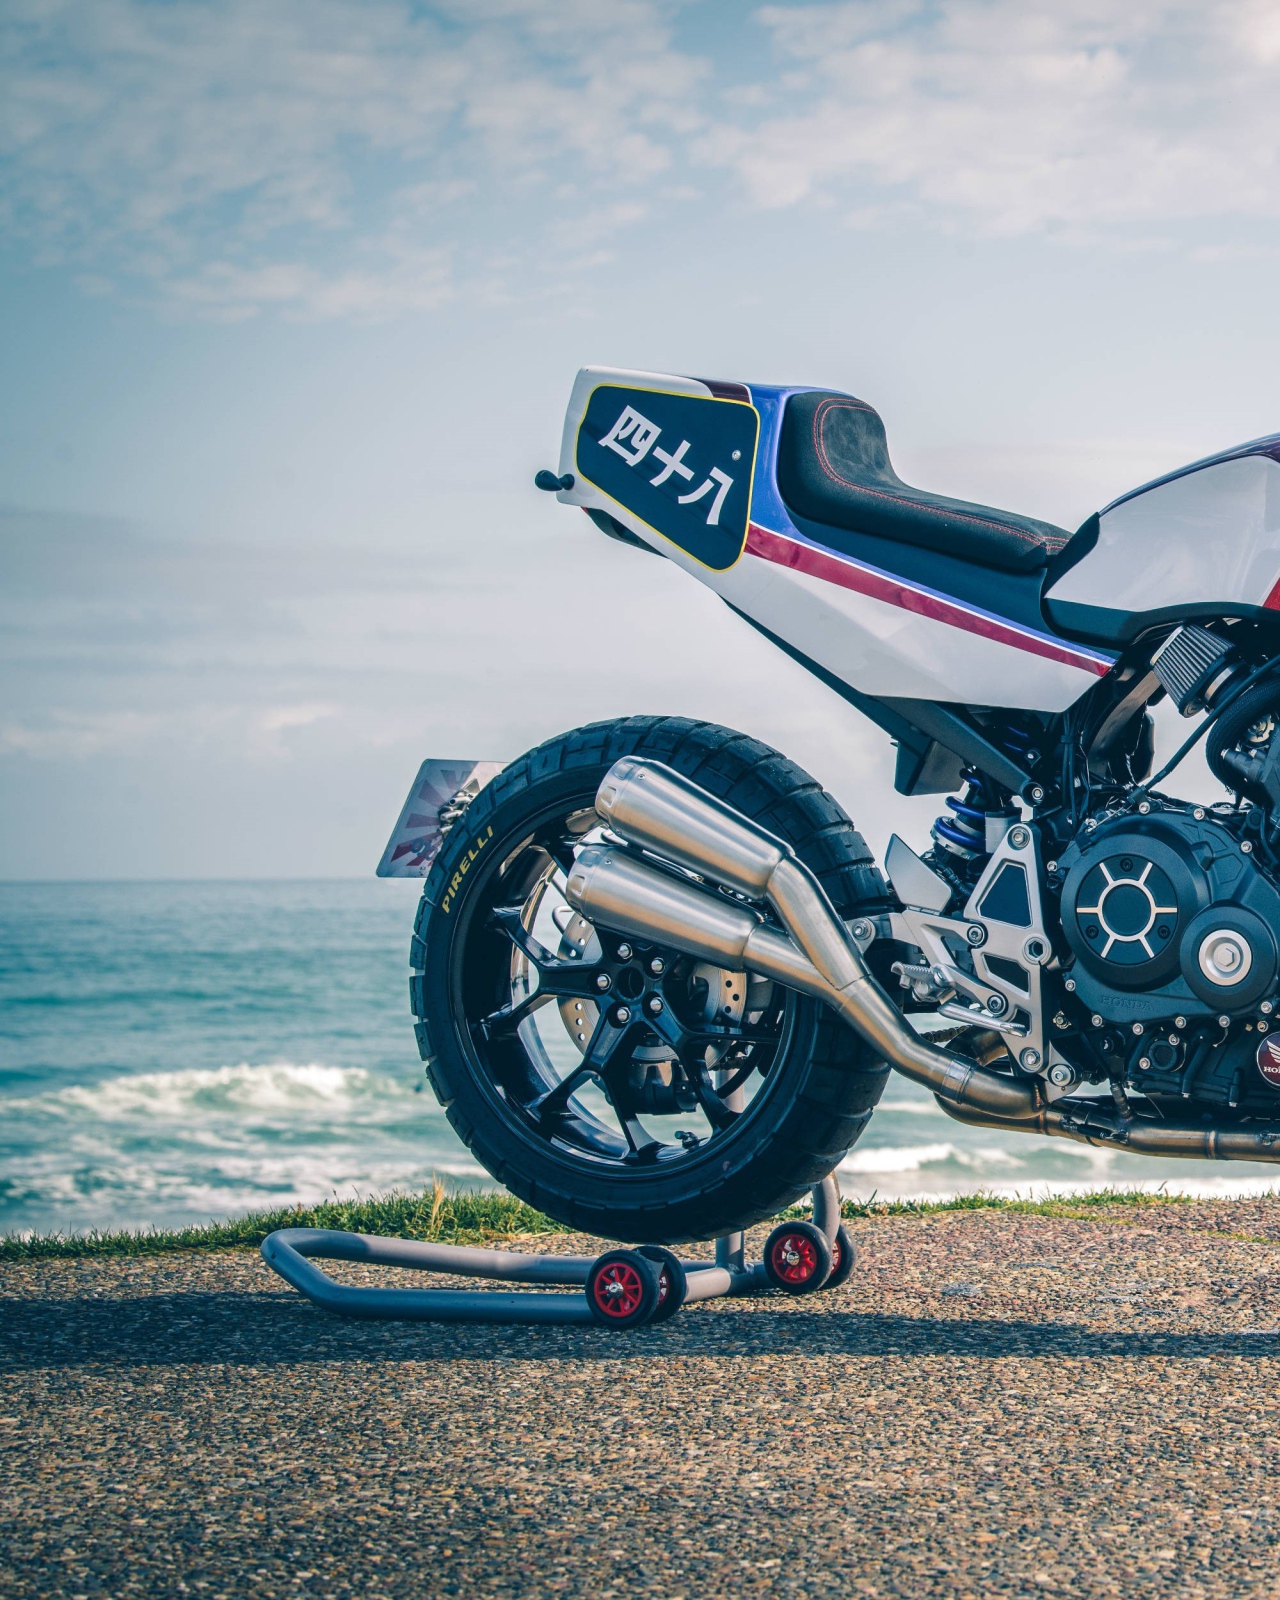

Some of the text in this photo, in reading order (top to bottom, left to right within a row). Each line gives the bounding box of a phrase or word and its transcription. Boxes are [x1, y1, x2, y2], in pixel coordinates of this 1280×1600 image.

[598, 405, 734, 525] 四十八
[442, 825, 494, 913] PIRELLI
[1101, 995, 1153, 1011] HONDA
